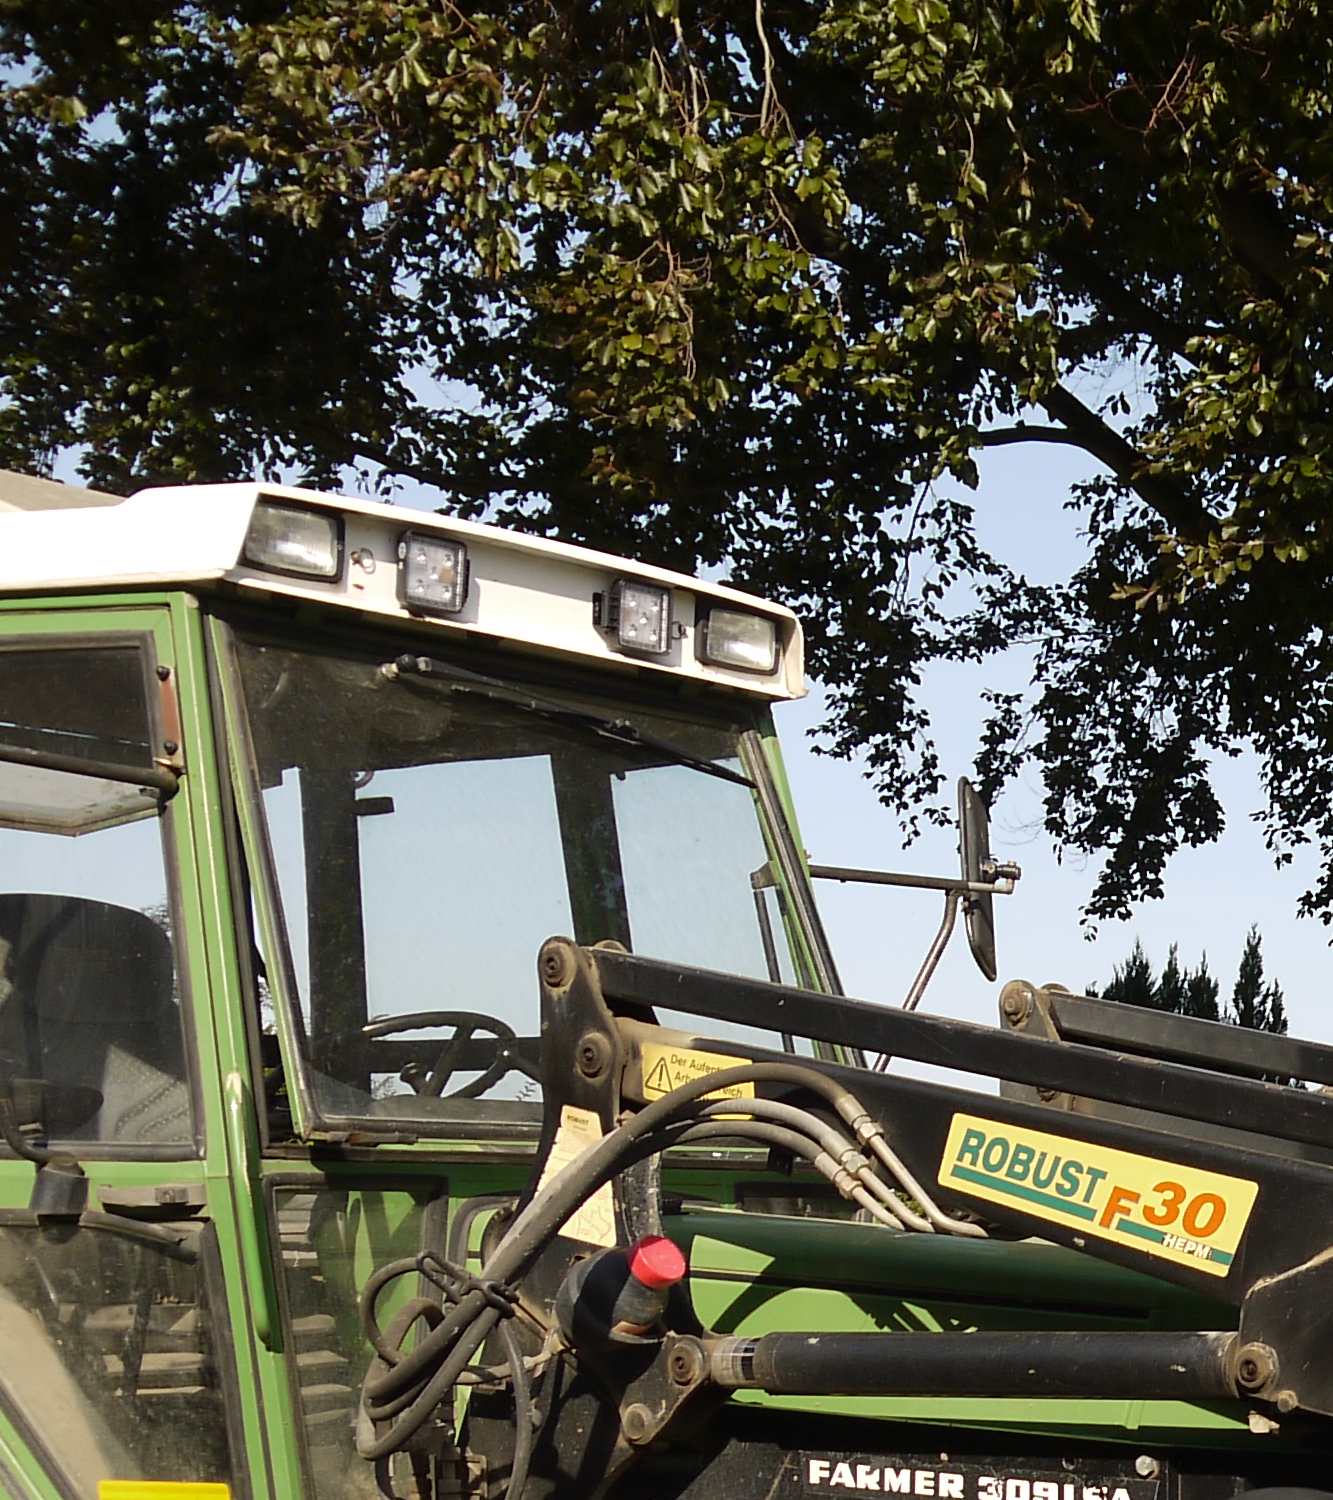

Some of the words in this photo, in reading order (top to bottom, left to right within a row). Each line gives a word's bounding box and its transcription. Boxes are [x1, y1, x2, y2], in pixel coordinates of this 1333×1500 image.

[671, 1054, 686, 1066] Der
[955, 1128, 1108, 1203] ROBUST
[1163, 1233, 1211, 1259] HEPM
[809, 1459, 964, 1499] FARMER
